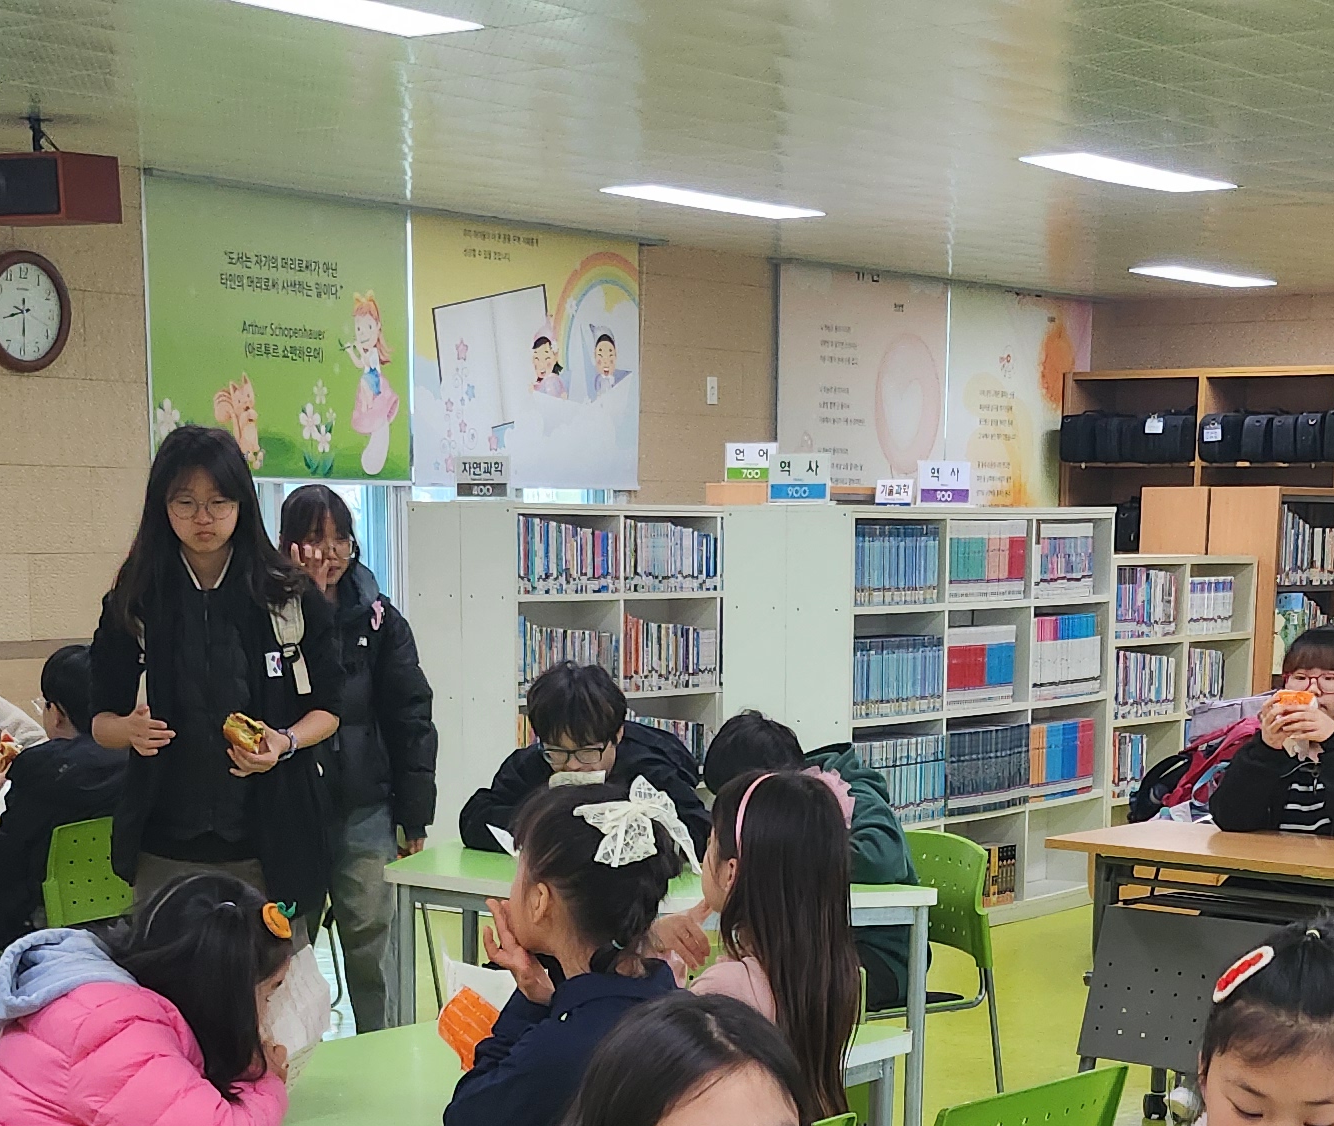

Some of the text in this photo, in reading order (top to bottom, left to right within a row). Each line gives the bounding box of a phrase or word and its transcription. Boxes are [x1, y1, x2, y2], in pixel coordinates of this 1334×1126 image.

[19, 266, 29, 280] 12
[241, 320, 268, 336] Arthur
[462, 461, 503, 477] 자연과학
[741, 469, 761, 479] 700
[787, 486, 809, 498] 900
[936, 490, 953, 502] 900
